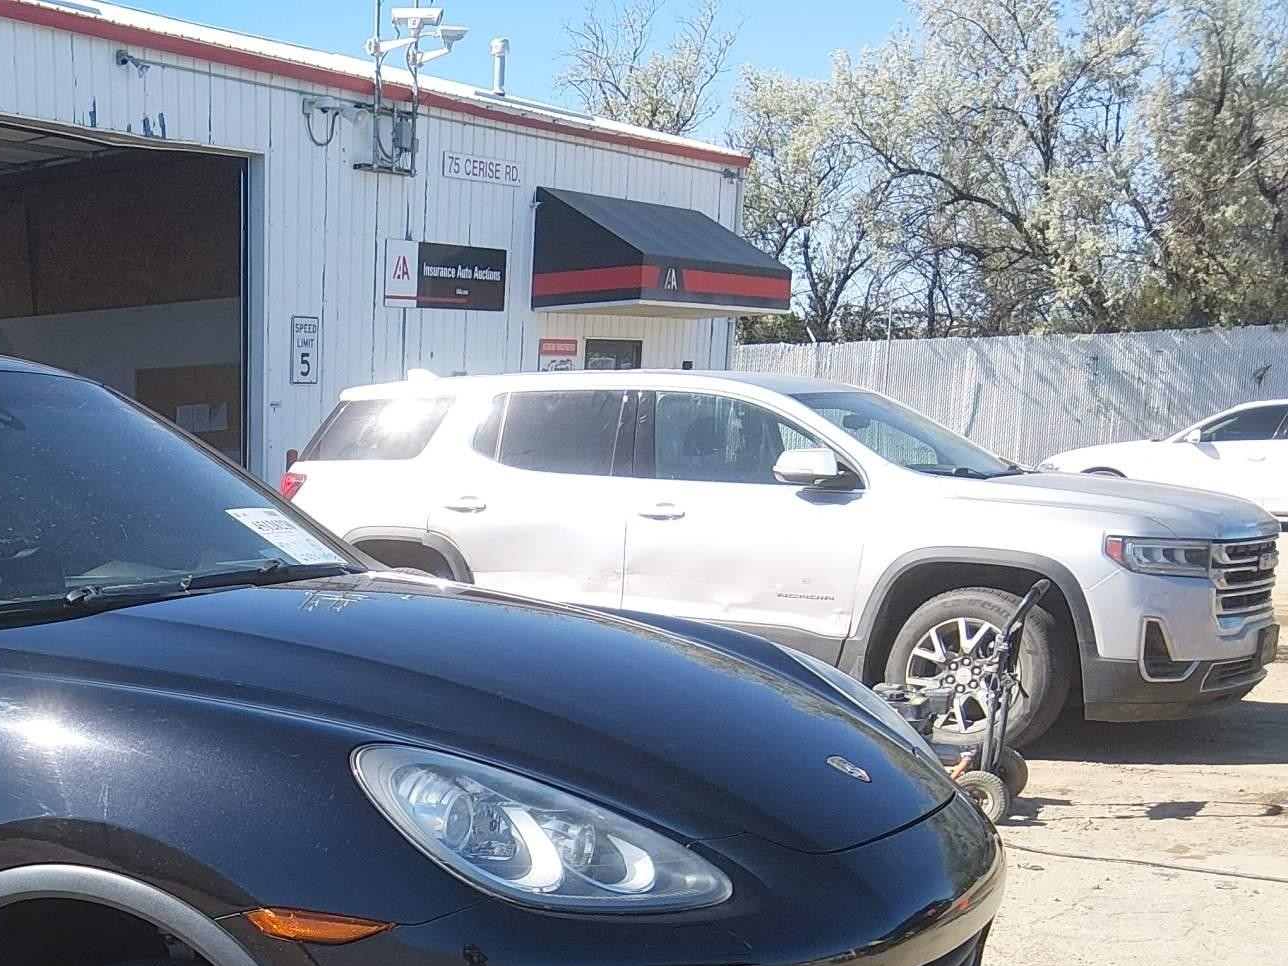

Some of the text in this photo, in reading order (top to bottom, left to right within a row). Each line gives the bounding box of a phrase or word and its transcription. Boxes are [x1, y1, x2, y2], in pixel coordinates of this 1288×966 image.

[448, 156, 521, 183] 75 CERISE RD.
[423, 261, 501, 281] Insurance Auto Auctions
[295, 323, 317, 333] SPEED
[296, 338, 314, 348] LIMIT
[300, 352, 311, 376] 5
